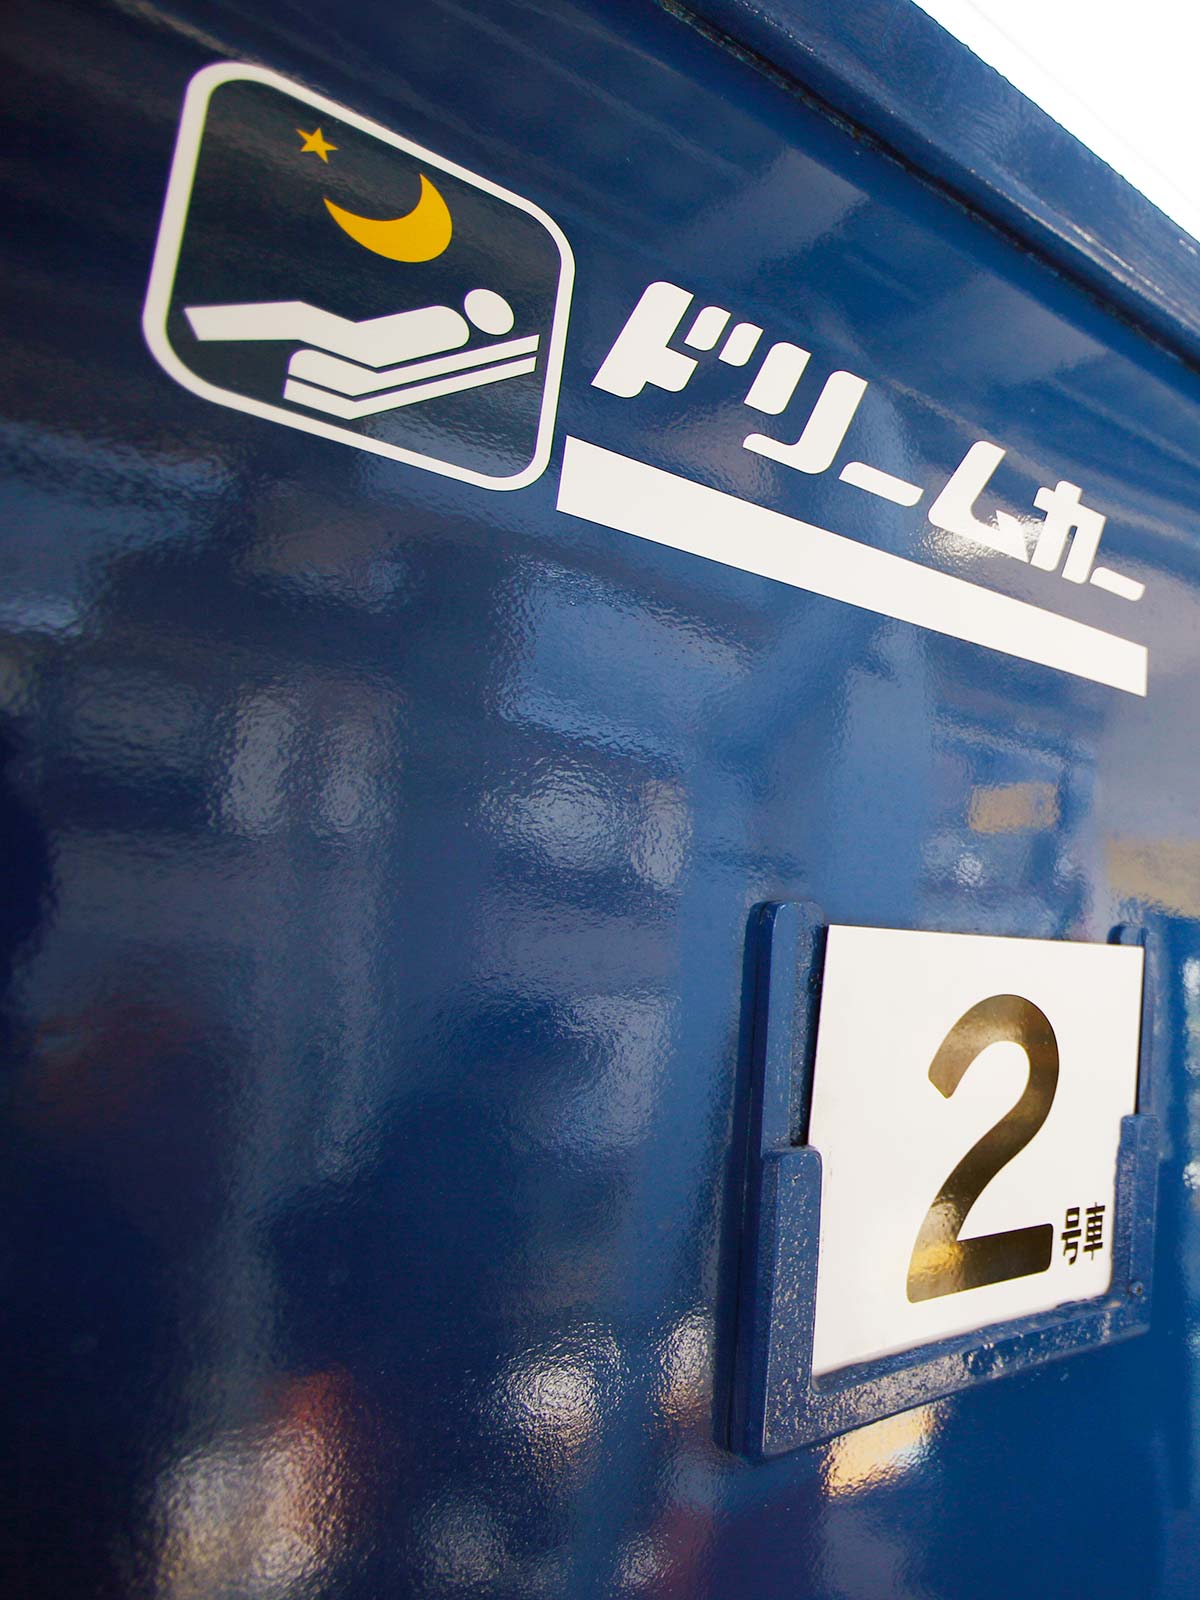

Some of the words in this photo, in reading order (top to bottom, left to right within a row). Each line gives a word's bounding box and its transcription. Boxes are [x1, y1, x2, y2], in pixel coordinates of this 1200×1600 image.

[590, 281, 1146, 601] ドリームカー
